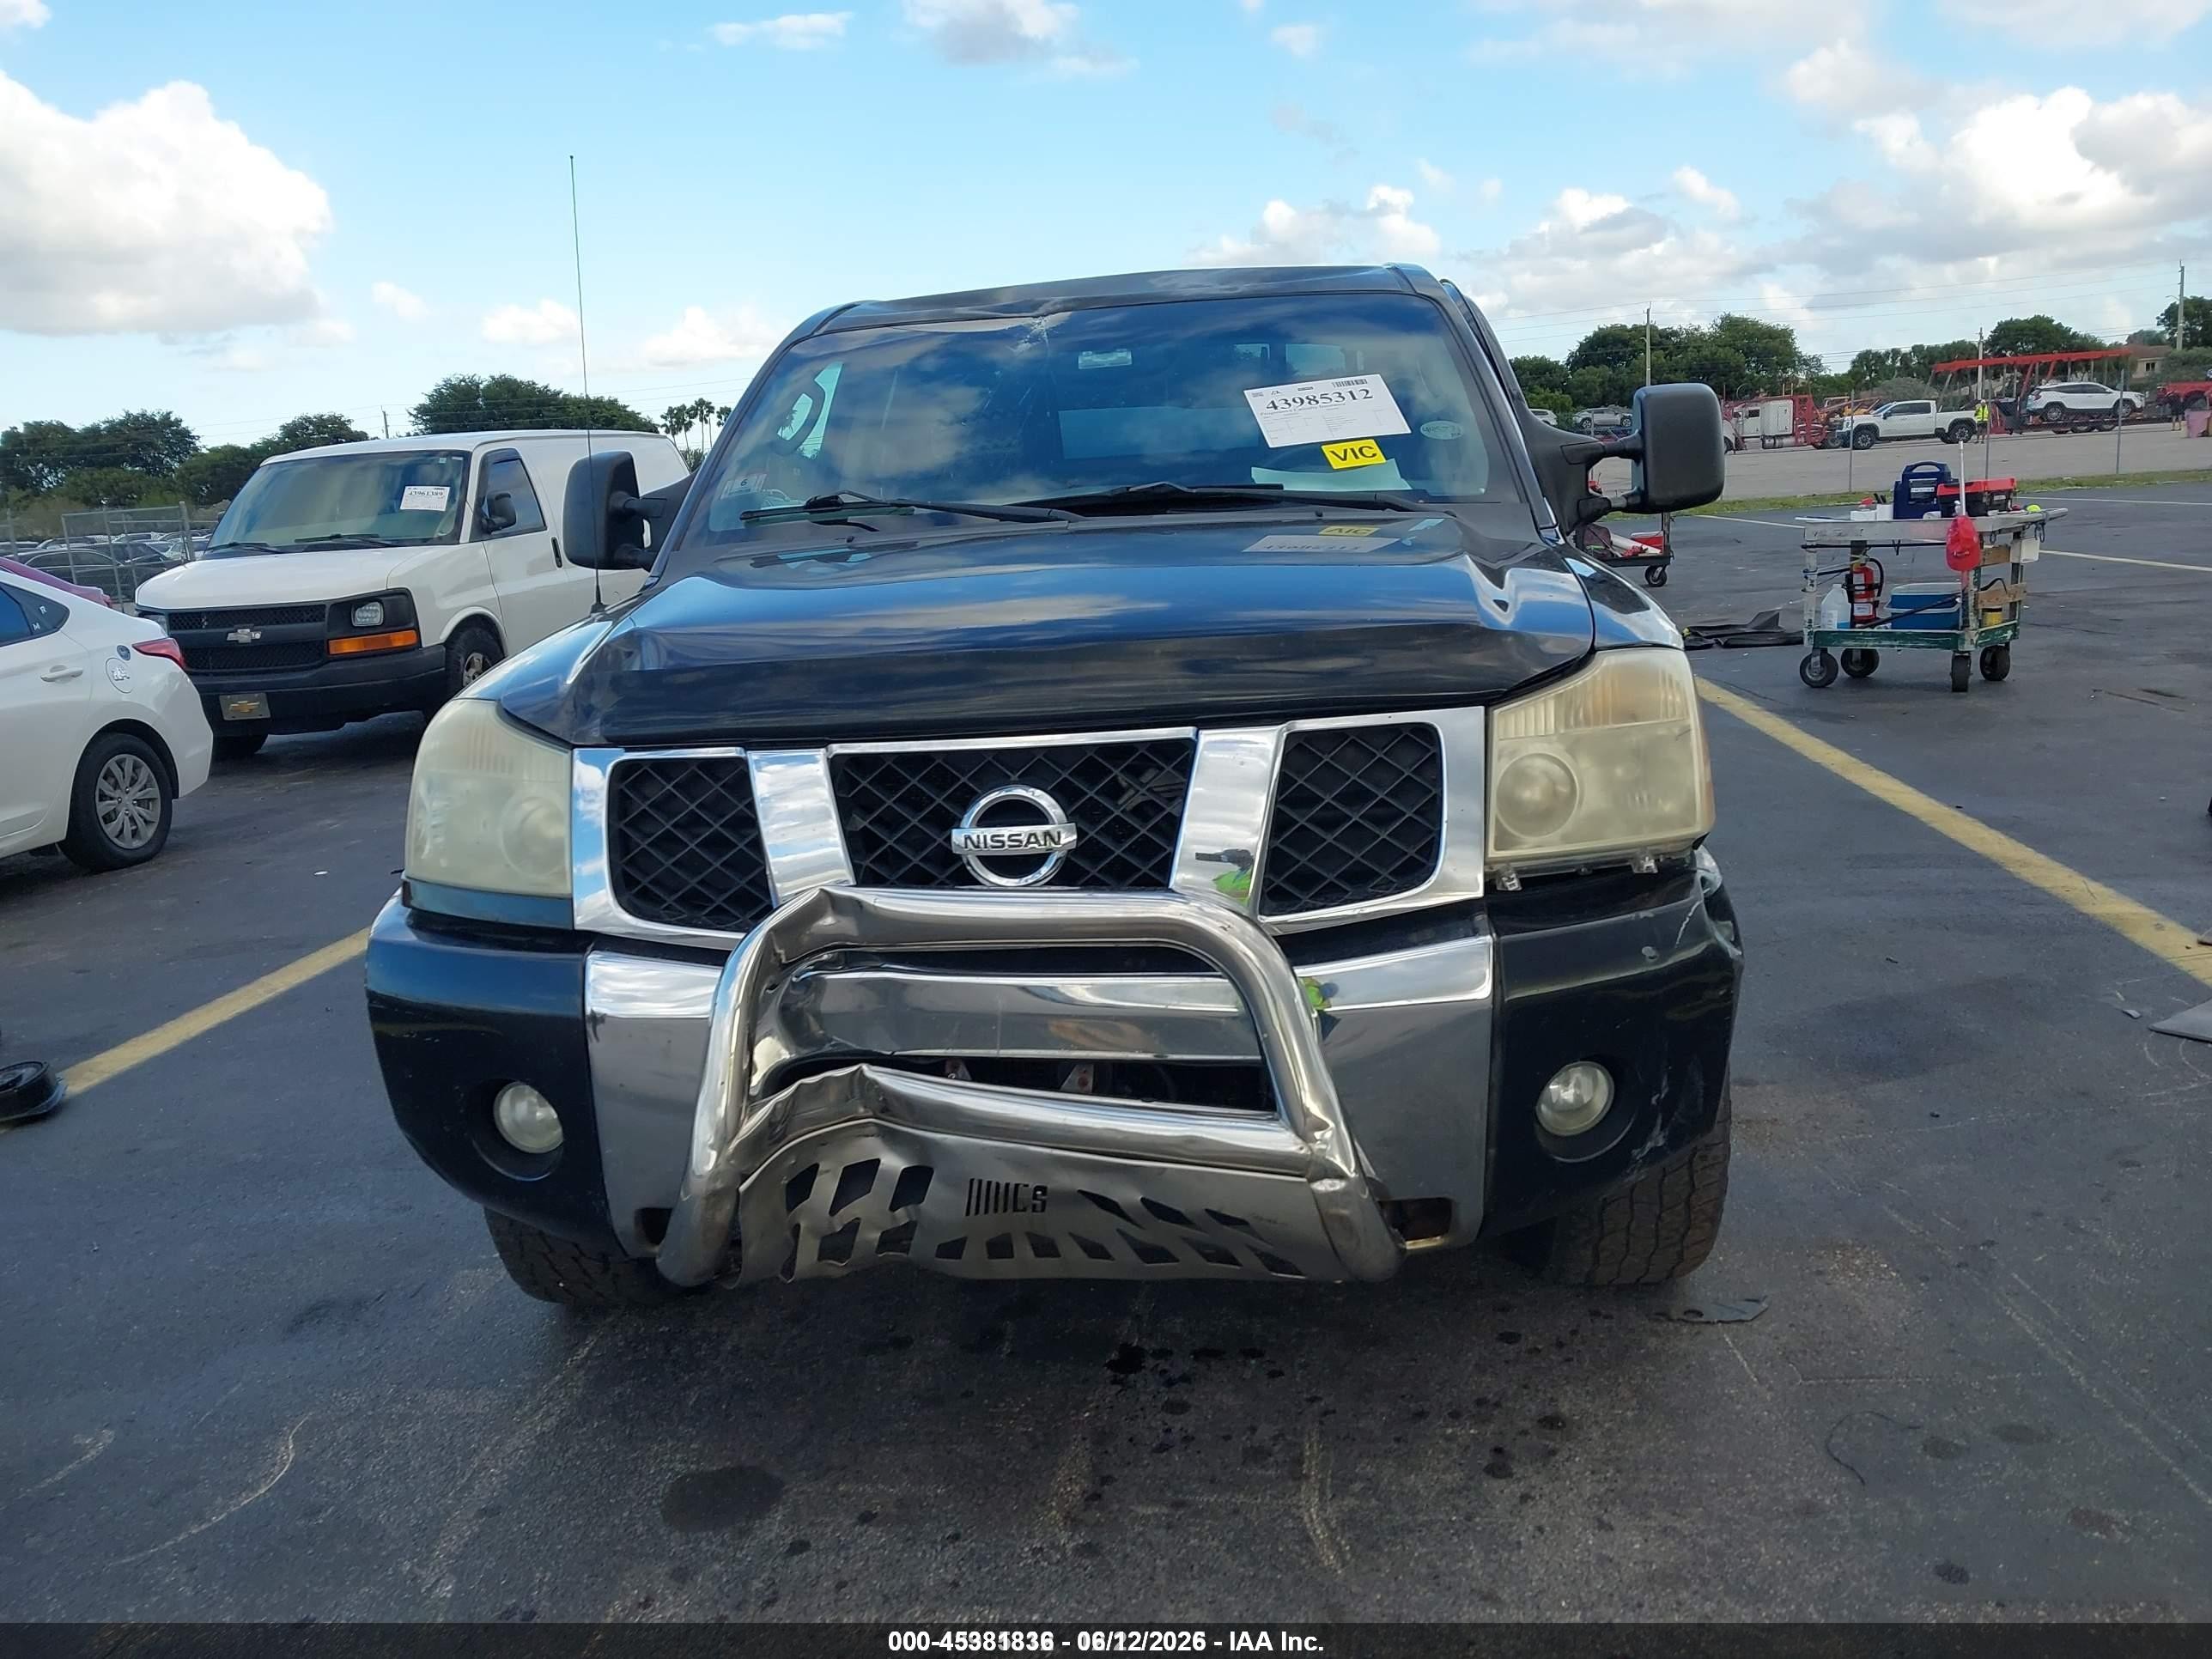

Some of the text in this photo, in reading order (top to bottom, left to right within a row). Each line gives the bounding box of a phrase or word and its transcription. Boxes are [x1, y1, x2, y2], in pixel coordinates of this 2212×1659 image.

[1266, 388, 1374, 410] 43985312
[1328, 446, 1377, 462] VIC
[963, 830, 1062, 849] NISSAN
